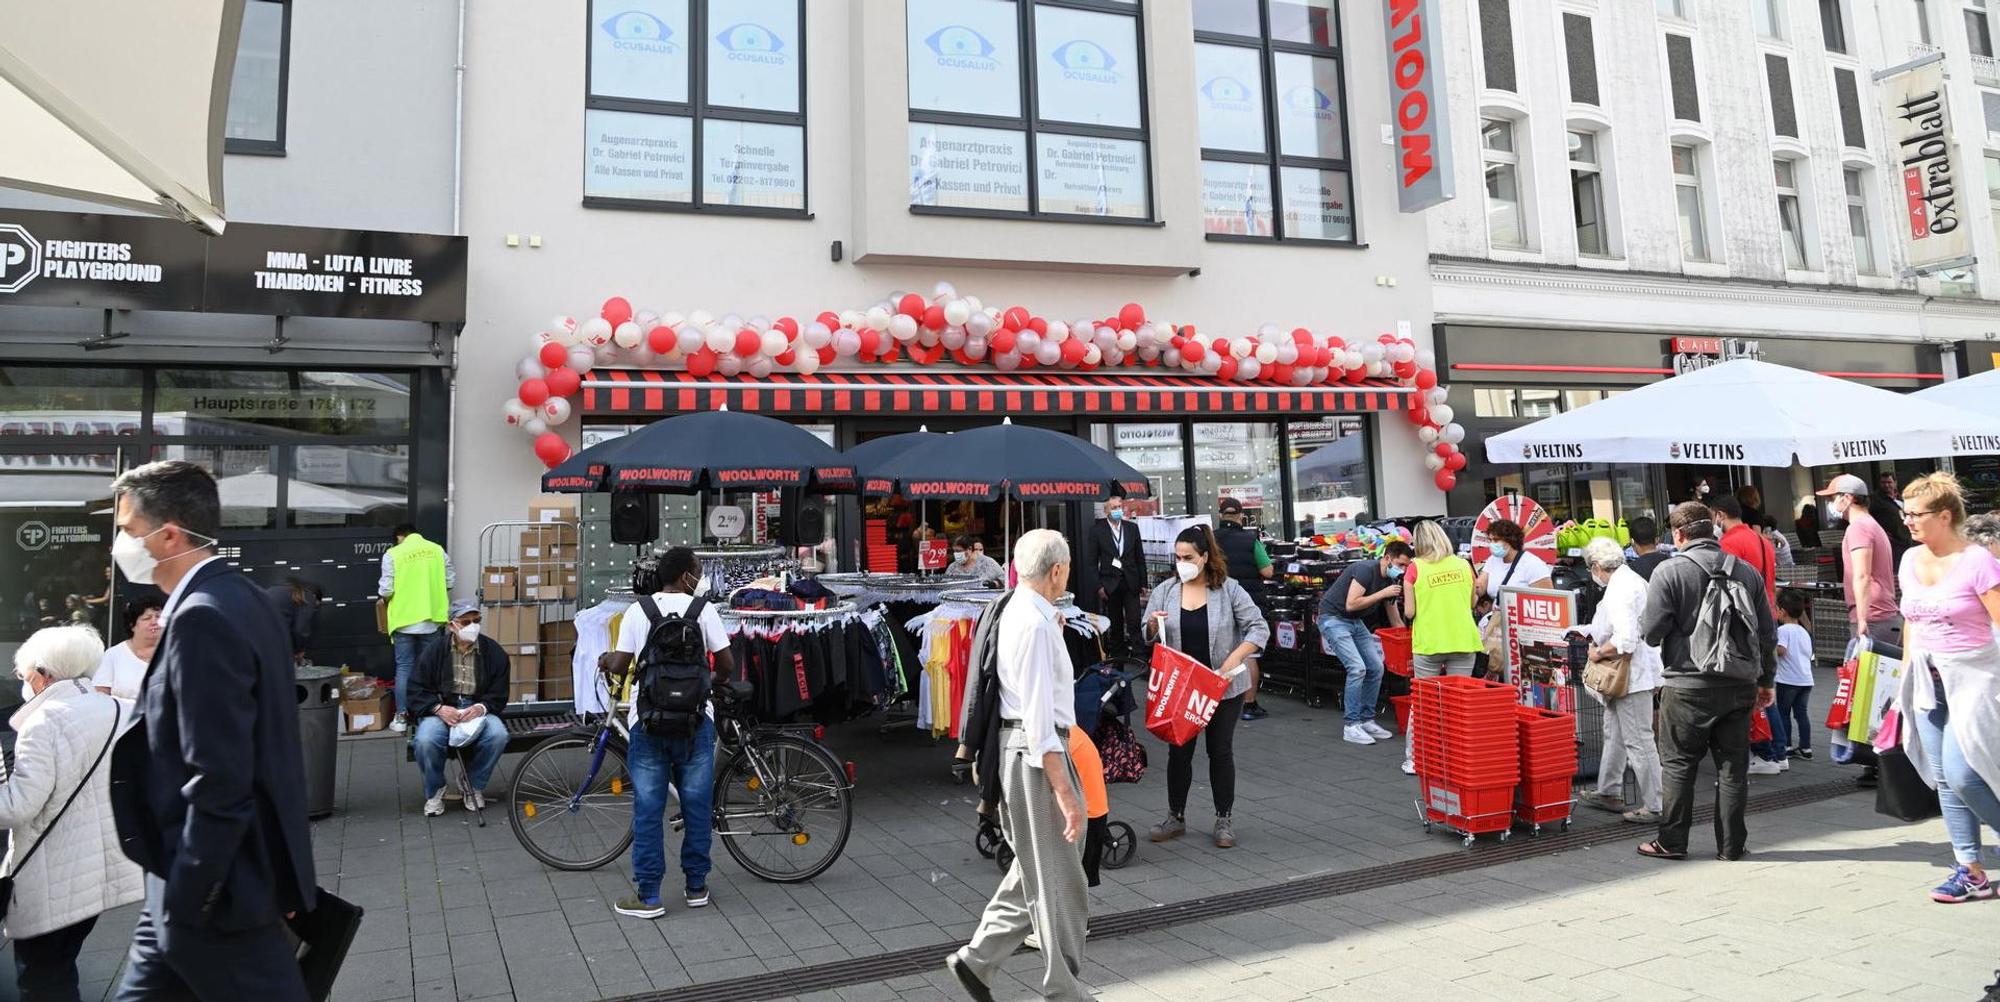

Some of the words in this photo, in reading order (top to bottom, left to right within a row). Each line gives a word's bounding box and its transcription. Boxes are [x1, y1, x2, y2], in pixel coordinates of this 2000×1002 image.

[613, 40, 673, 54] OCUSALUS
[728, 52, 785, 65] OCUSALUS
[937, 57, 996, 71] OCUSALUS
[1064, 70, 1118, 84] OCUSALUS
[600, 134, 678, 149] Augenarztpraxis
[608, 148, 641, 160] Gabriel
[644, 151, 685, 163] Petrovici
[734, 144, 775, 157] Schnelle
[1062, 149, 1094, 161] Gabriel
[720, 158, 790, 172] Terminvergabe
[973, 159, 1023, 174] Petrovici
[1896, 90, 1958, 235] extrablatt
[612, 166, 641, 177] Kassen
[643, 168, 658, 178] und
[660, 169, 684, 180] Privat
[935, 178, 970, 192] Kassen
[973, 182, 991, 193] und
[993, 182, 1022, 196] Privat
[45, 240, 132, 261] FIGHTERS
[266, 251, 308, 270] MMA
[324, 254, 365, 273] LUTA
[369, 257, 413, 276] LIVRE
[43, 260, 162, 283] PLAYGROUND
[254, 271, 344, 292] THAIBOXEN
[360, 277, 423, 296] FITNESS
[194, 396, 298, 413] Hauptstraße
[1841, 439, 1887, 457] VELTINS
[1959, 435, 2000, 450] VELTINS
[1533, 443, 1583, 458] VELTINS
[1683, 443, 1744, 460] VELTINS
[620, 468, 692, 481] WOOLWORTH
[718, 469, 800, 482] WOOLWORTH
[910, 482, 990, 496] WOOLWORTH
[1018, 482, 1100, 496] WOOLWORTH
[718, 514, 738, 528] 2.99
[51, 526, 88, 534] FIGHTERS
[928, 548, 947, 565] 2.99
[1522, 598, 1561, 622] NEU
[1154, 666, 1180, 718] WOOLWORTH
